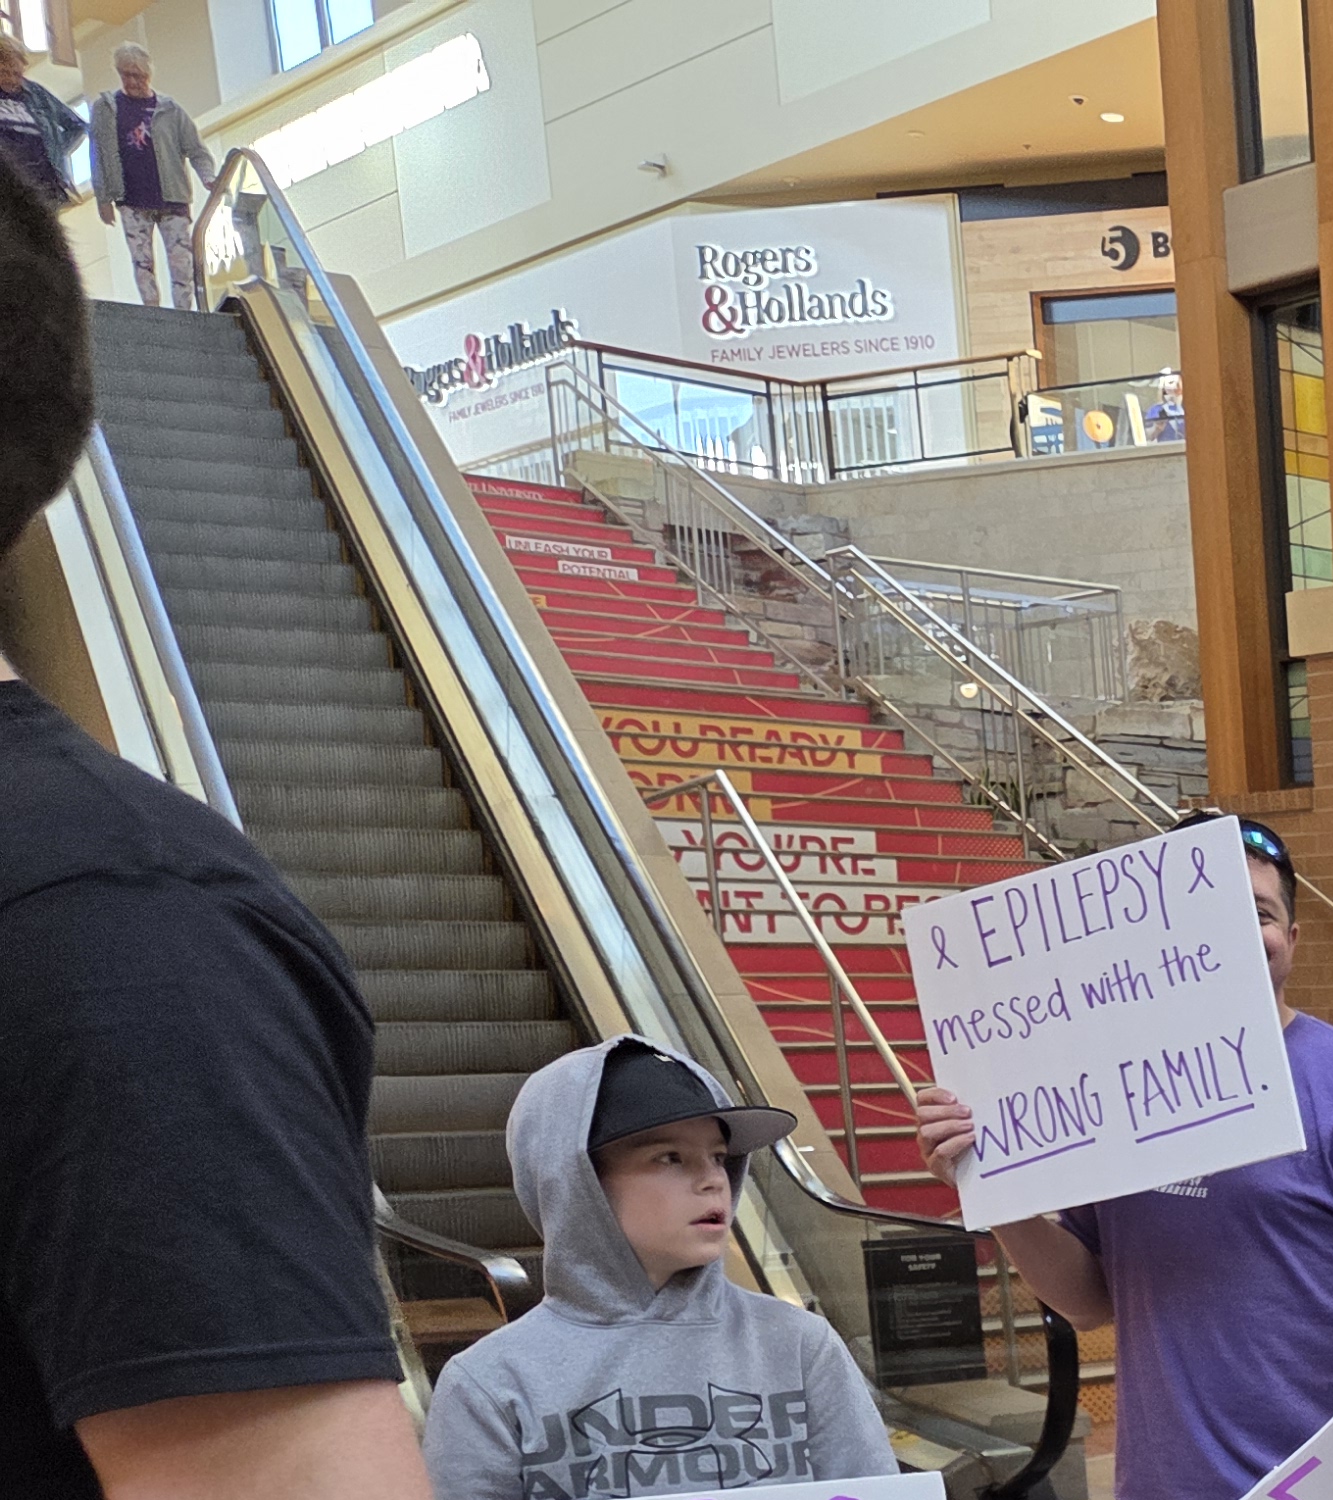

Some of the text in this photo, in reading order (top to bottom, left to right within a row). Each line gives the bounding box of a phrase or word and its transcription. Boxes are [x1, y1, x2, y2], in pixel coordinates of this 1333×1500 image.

[697, 244, 814, 286] Rogers
[710, 334, 935, 363] FAMILY JEWELERS SINCE 1910
[508, 539, 608, 560] UNLEASH YOUR
[562, 564, 631, 580] POTENTIAL
[700, 724, 857, 770] READY
[970, 842, 1171, 968] EPILEPSY
[932, 942, 1221, 1056] messed with the
[973, 1026, 1268, 1162] WRONG FAMILY.
